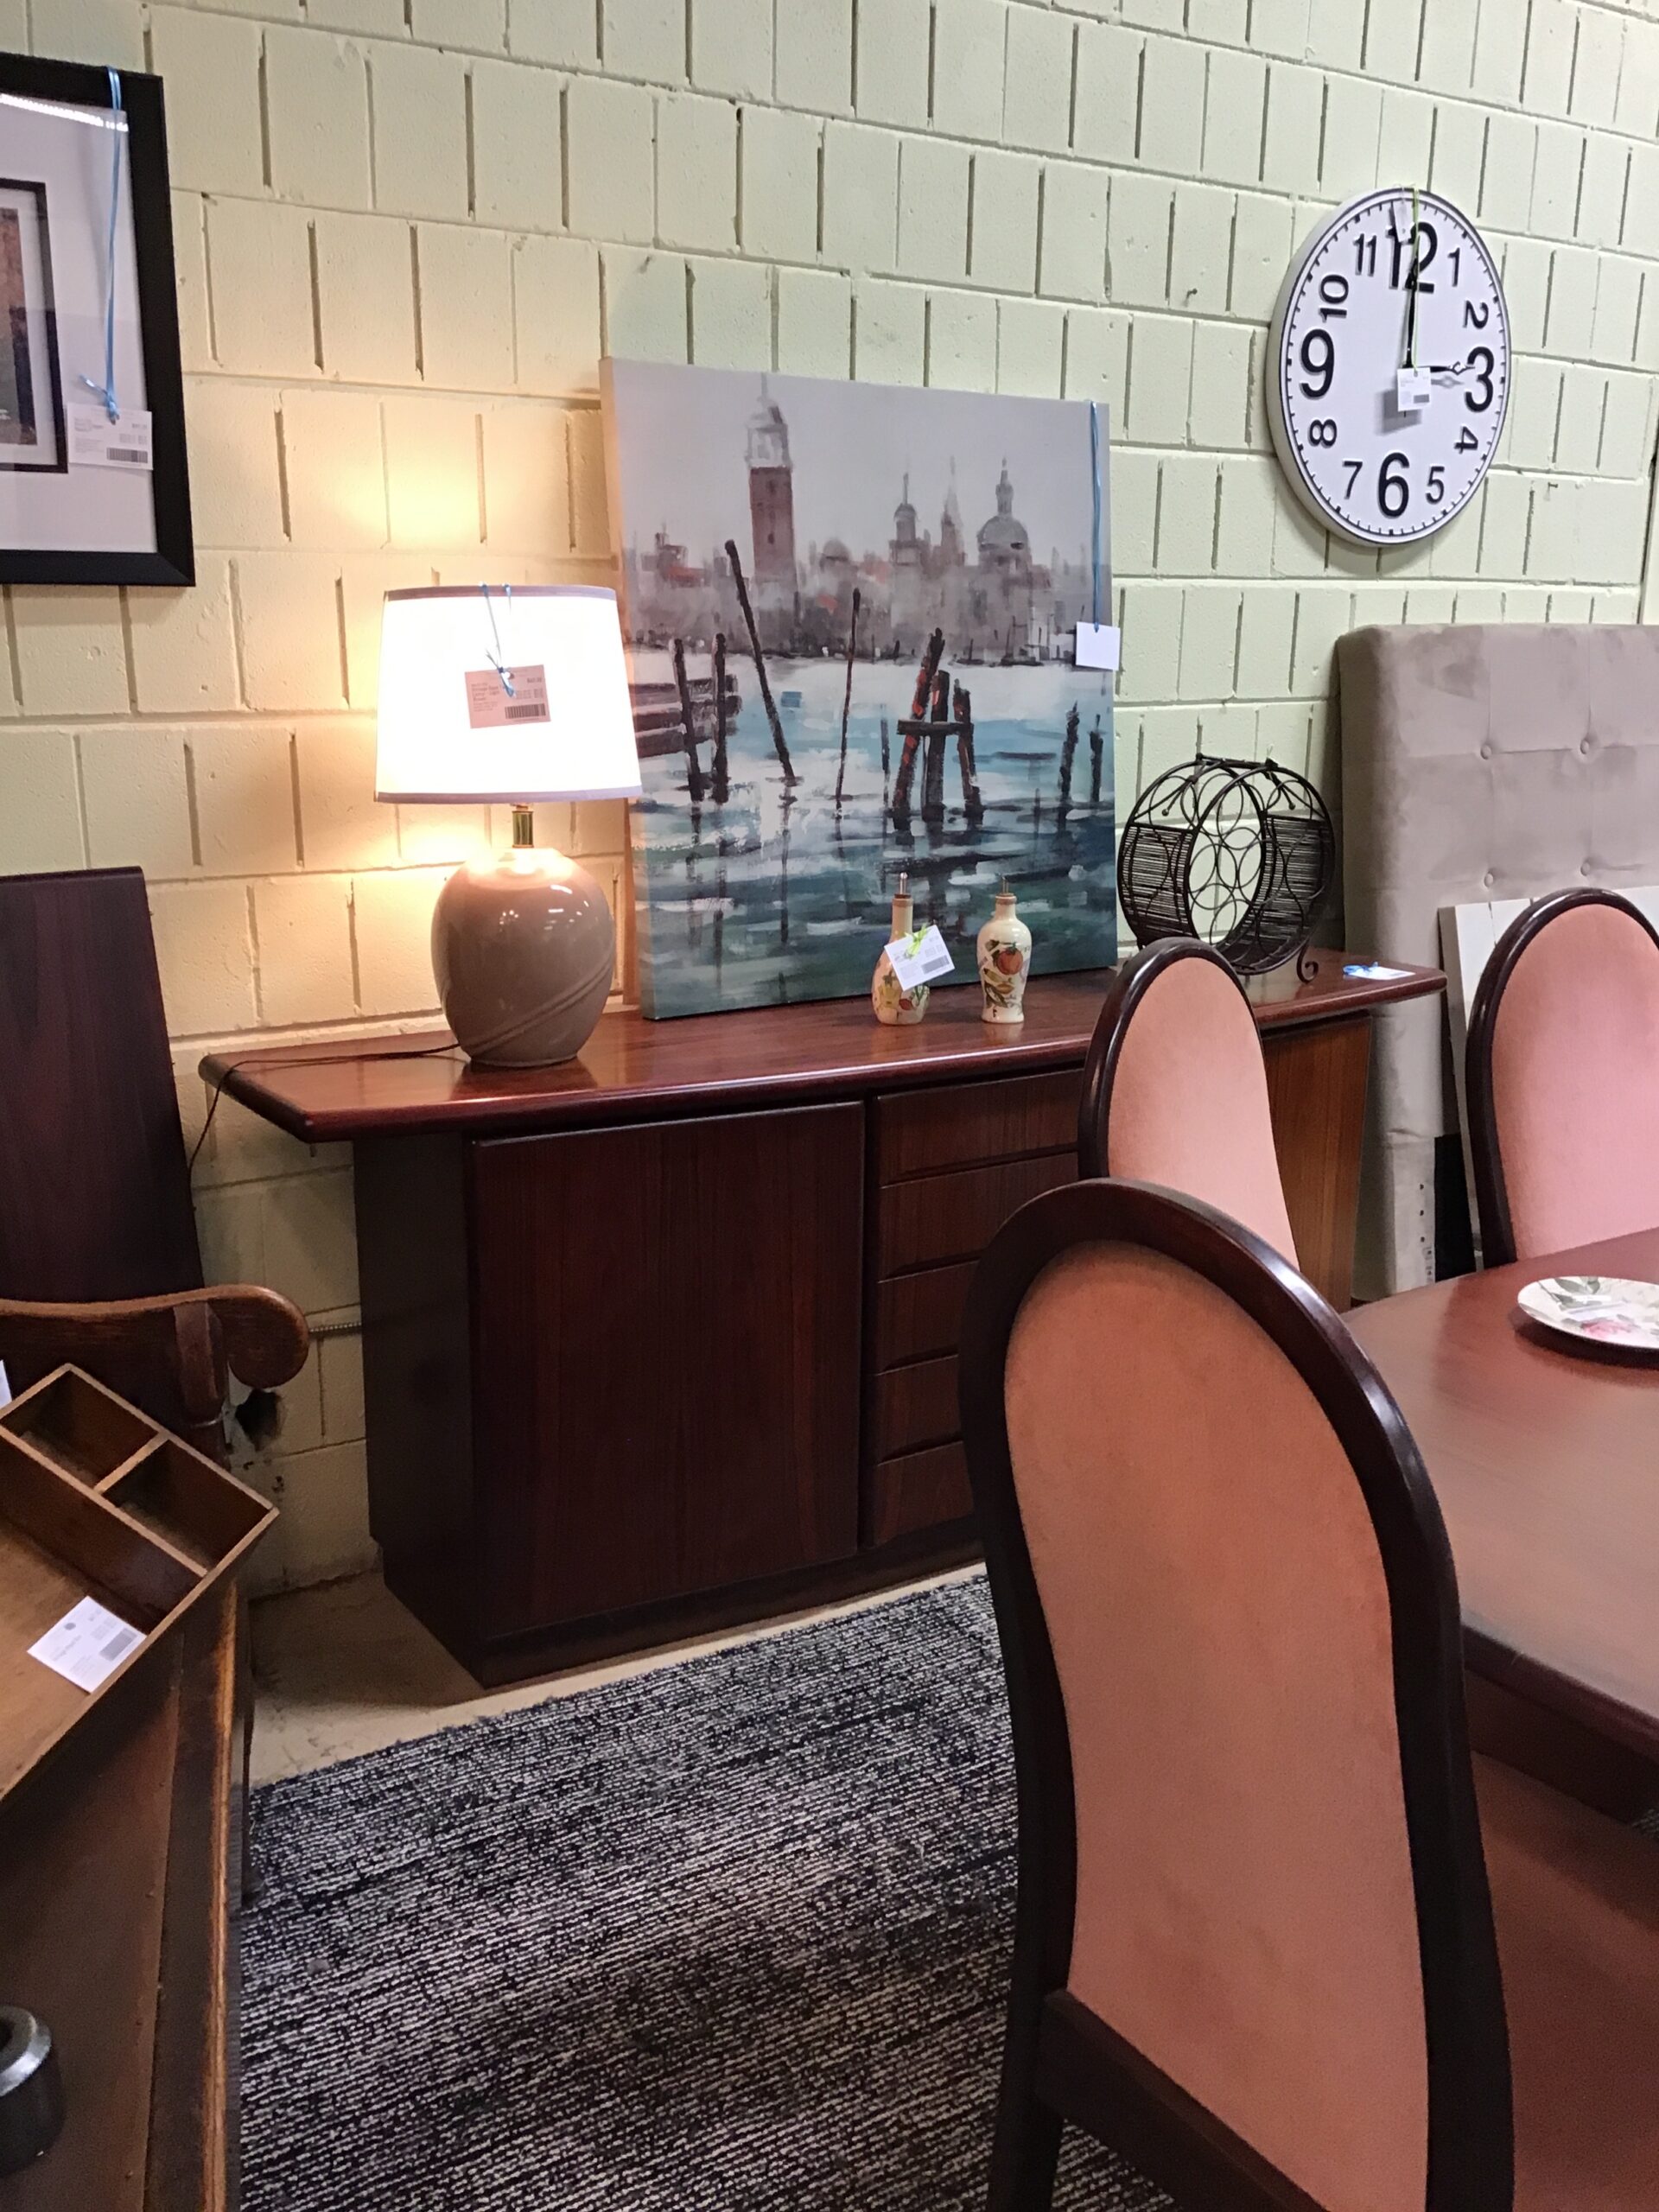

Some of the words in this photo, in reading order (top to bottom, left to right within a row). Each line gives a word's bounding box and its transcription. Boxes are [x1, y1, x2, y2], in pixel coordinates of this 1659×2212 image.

[1354, 233, 1377, 276] 11
[1388, 221, 1438, 294] 12
[1448, 247, 1460, 287] 1
[1319, 274, 1349, 322] 10
[1465, 301, 1489, 329] 2
[1300, 329, 1335, 398] 9
[1465, 346, 1495, 412] 3
[1309, 420, 1338, 448] 8
[1454, 427, 1478, 454] 4
[1343, 461, 1363, 499] 7
[1378, 453, 1410, 518] 6
[1427, 467, 1446, 504] 5
